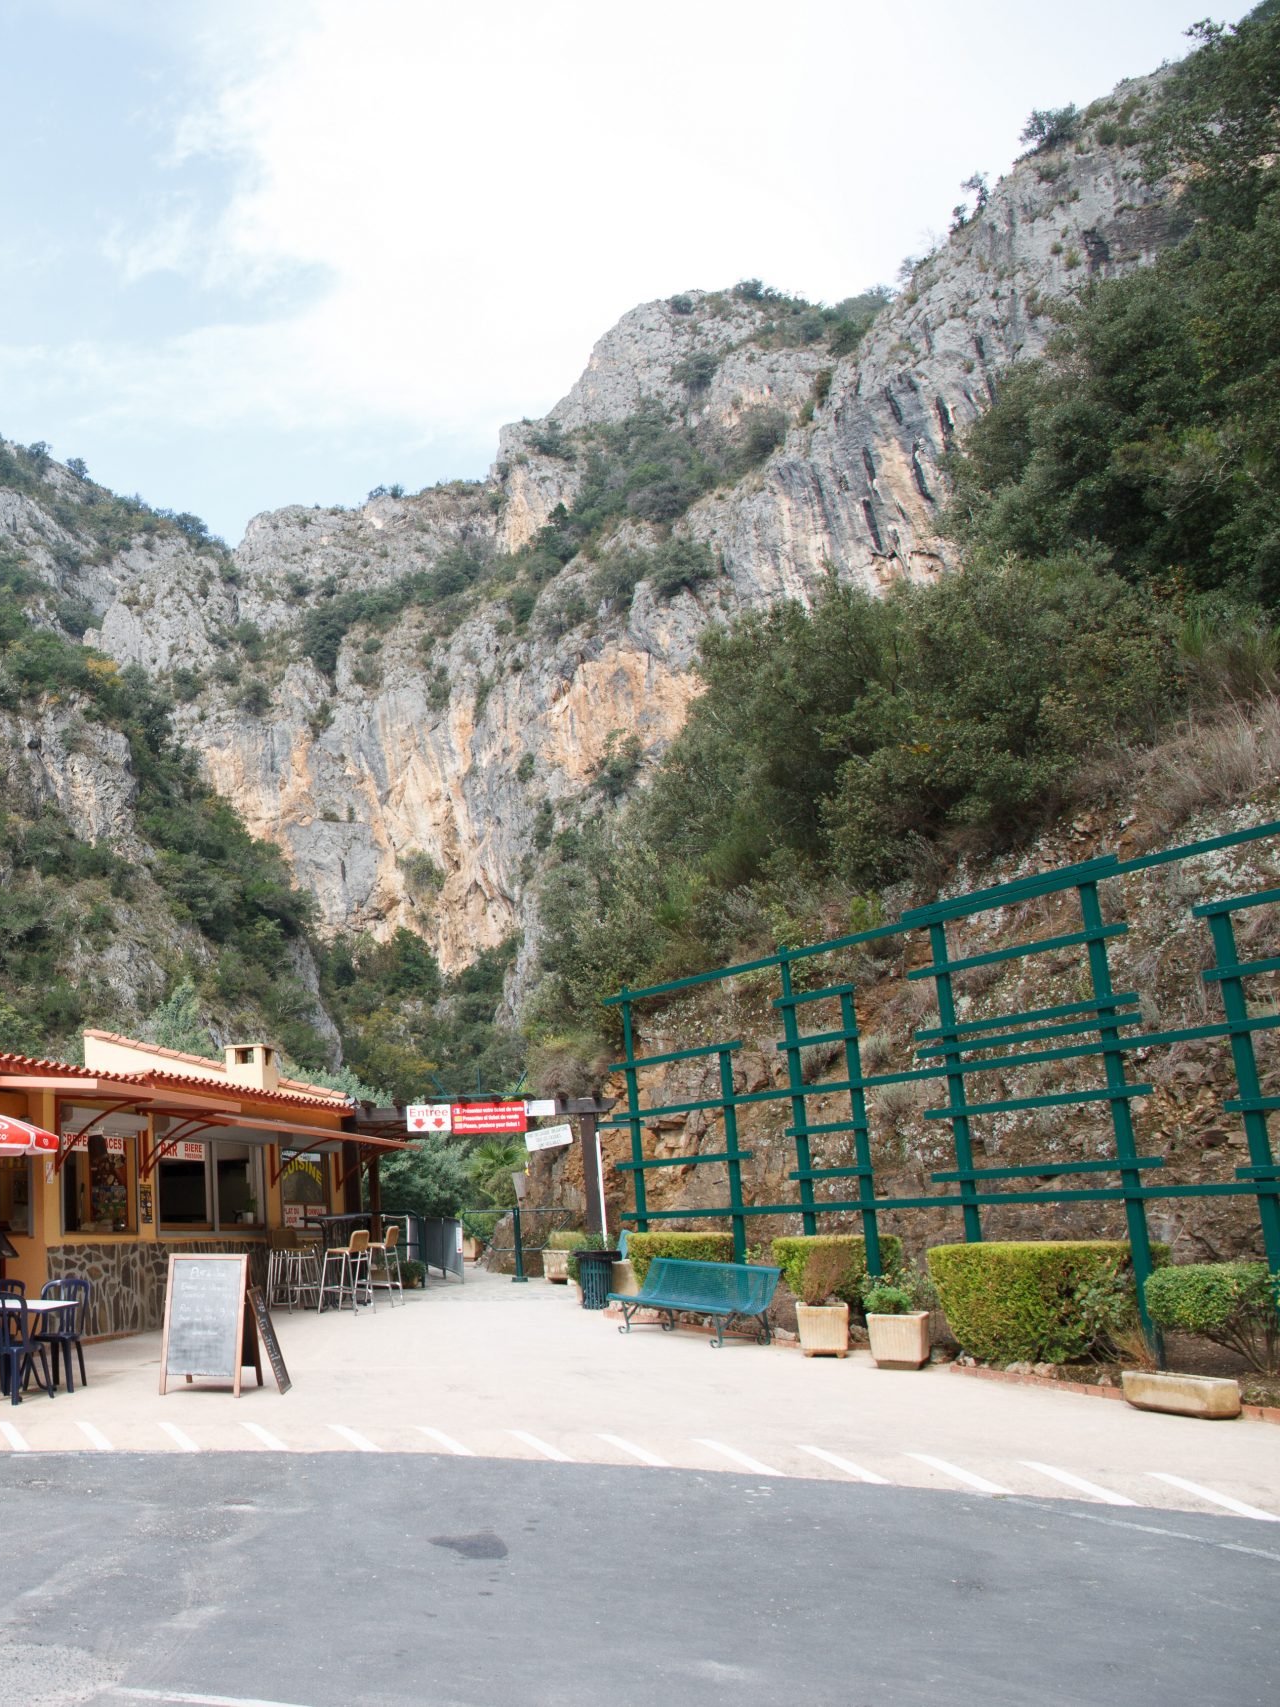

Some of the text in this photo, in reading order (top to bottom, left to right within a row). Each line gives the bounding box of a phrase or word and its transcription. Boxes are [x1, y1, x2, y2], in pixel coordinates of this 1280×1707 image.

[409, 1108, 448, 1118] Entrée
[160, 1140, 203, 1157] BAR BIERE
